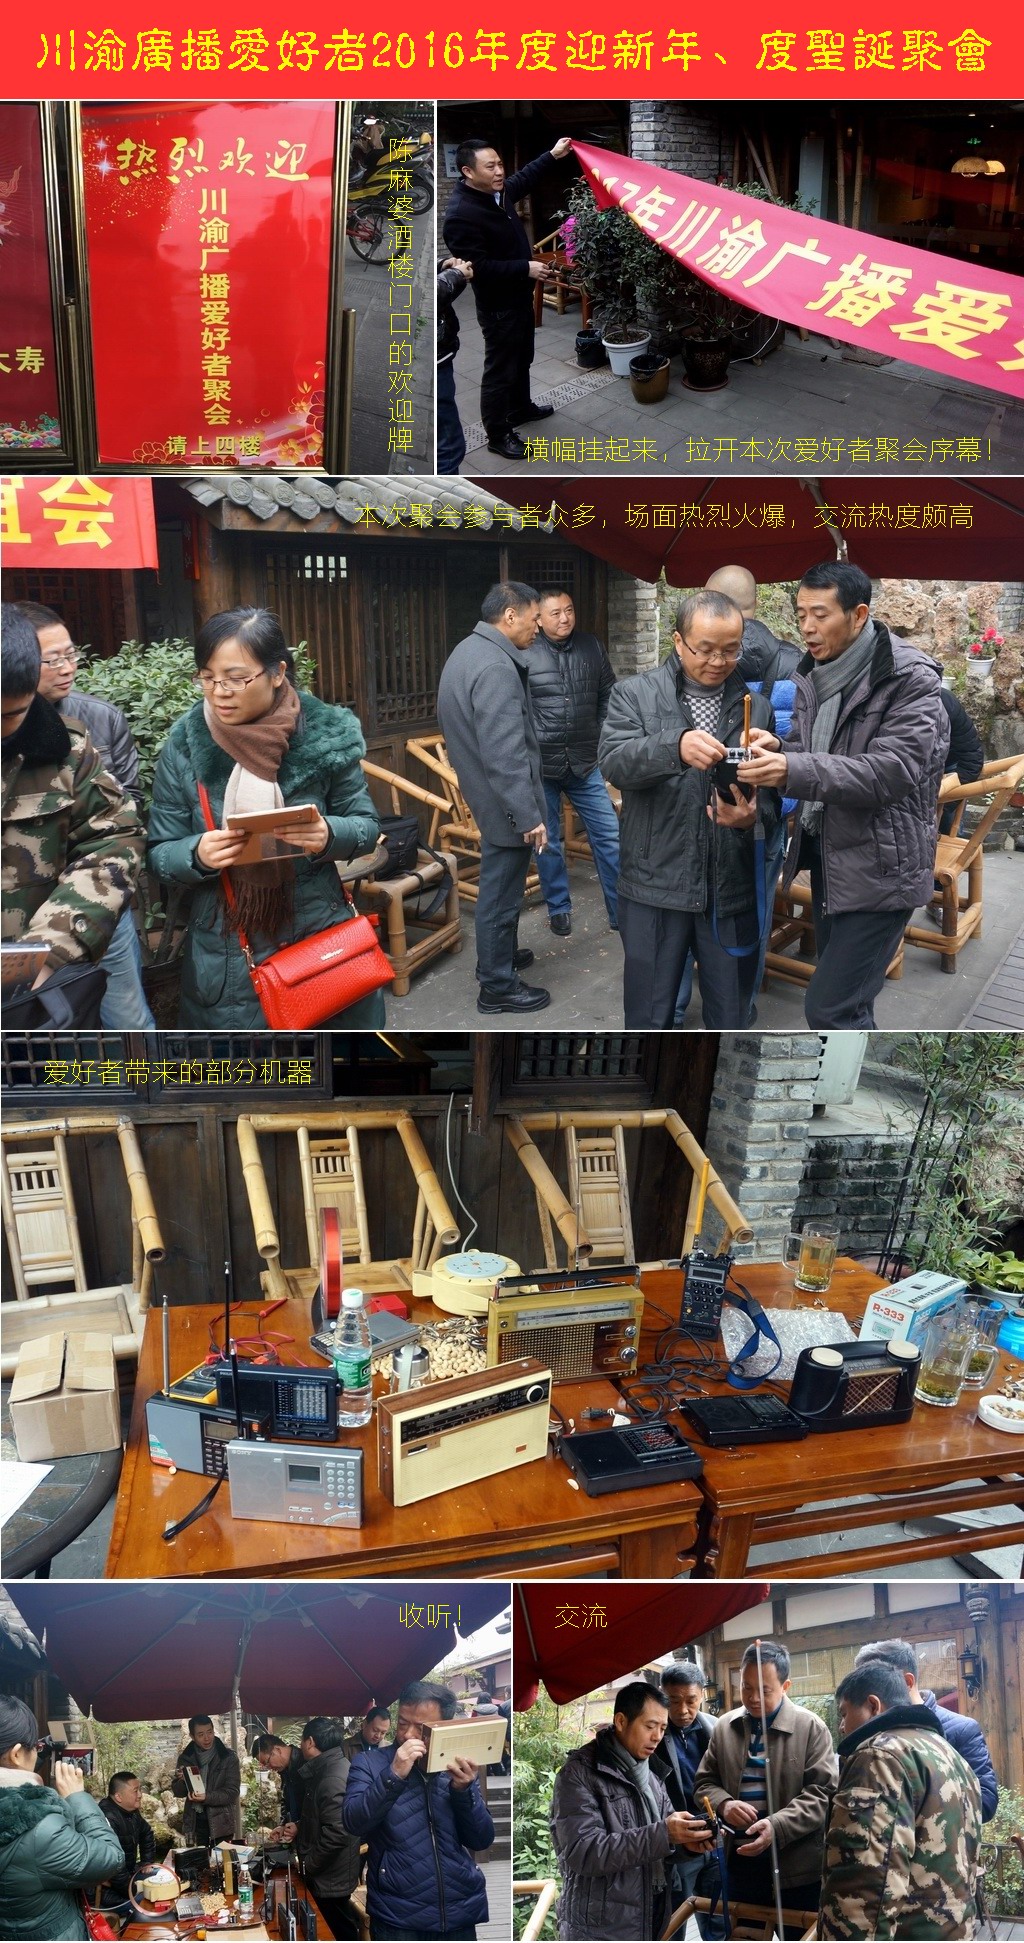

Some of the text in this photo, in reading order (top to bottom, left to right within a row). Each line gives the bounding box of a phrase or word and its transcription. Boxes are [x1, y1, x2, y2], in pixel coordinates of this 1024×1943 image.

[116, 136, 310, 186] 热烈欢迎
[198, 188, 232, 426] 川渝广播爱好者聚会
[166, 434, 262, 457] 请上四楼
[872, 1302, 905, 1322] R-333
